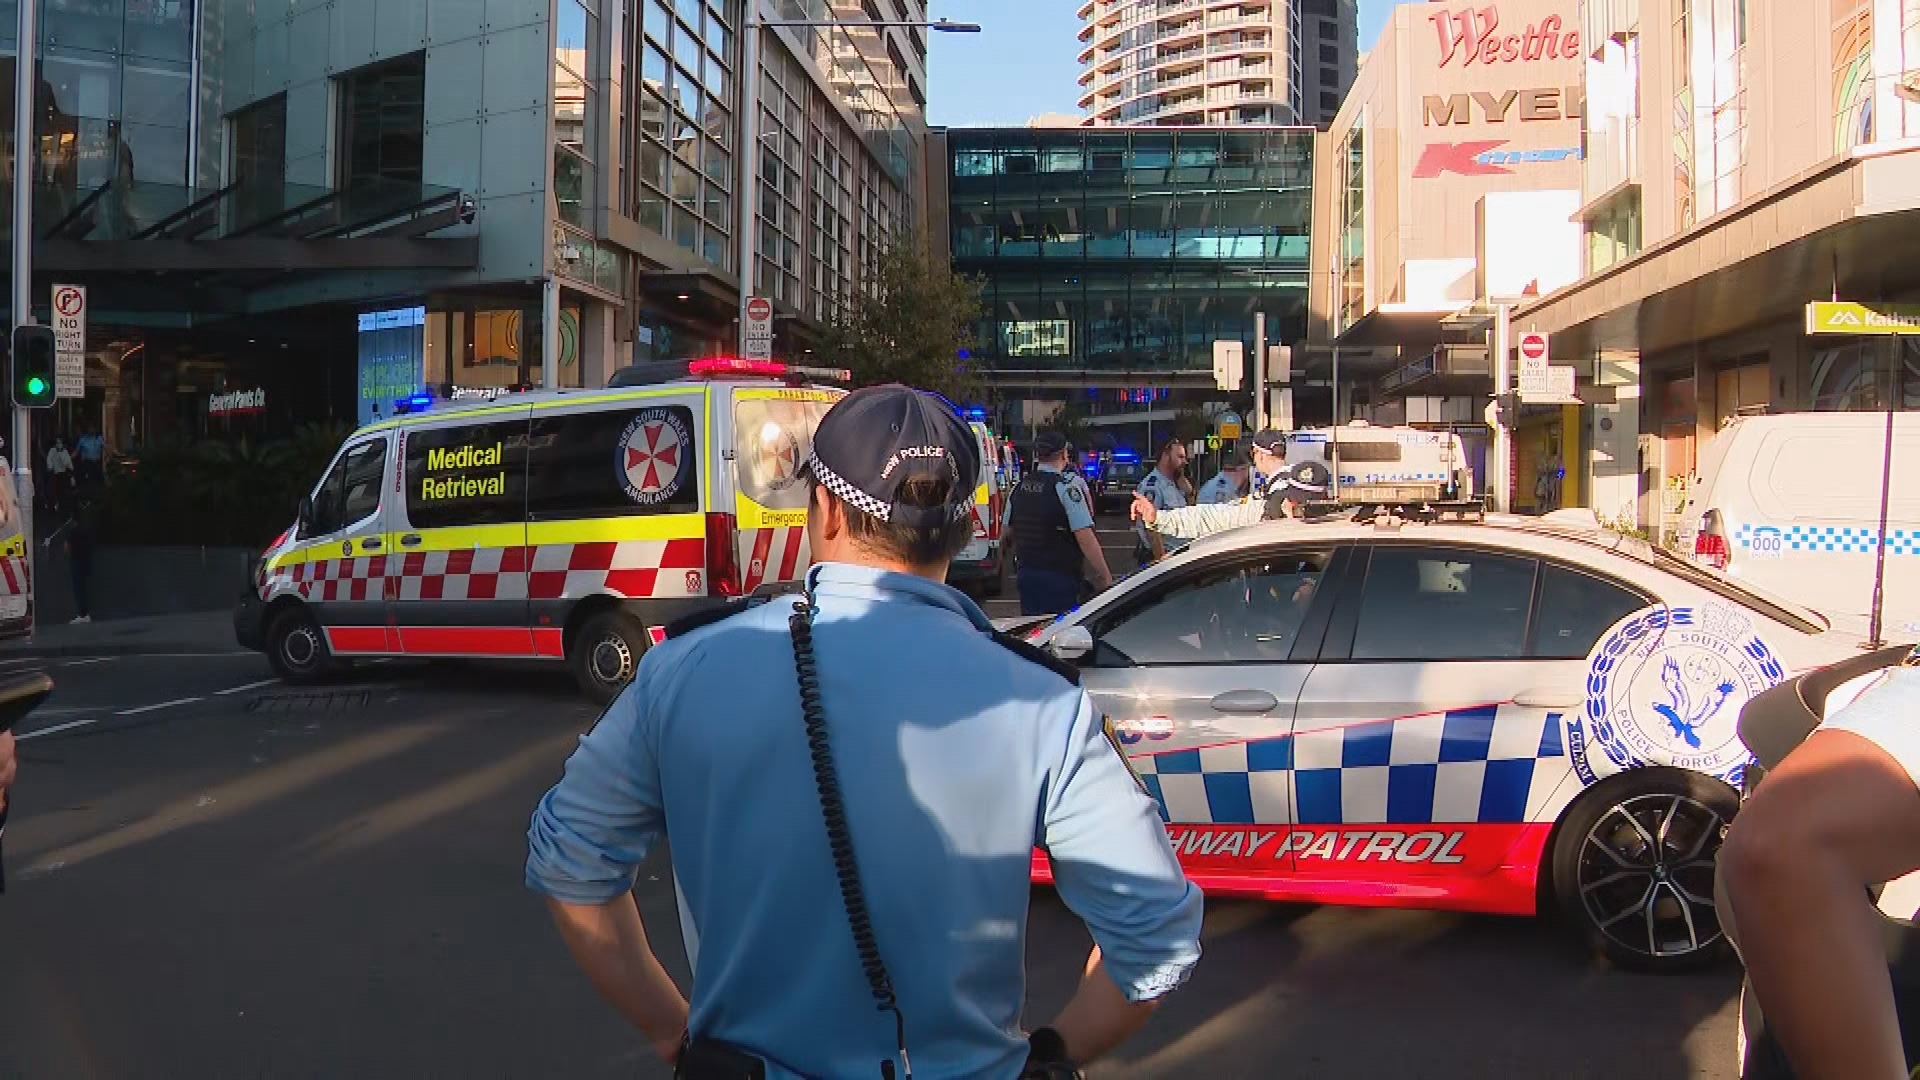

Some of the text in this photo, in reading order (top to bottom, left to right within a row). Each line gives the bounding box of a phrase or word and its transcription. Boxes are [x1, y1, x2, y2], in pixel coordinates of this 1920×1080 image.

[1428, 4, 1579, 68] Westfie
[60, 317, 78, 329] NO
[752, 323, 766, 331] NO
[1864, 311, 1920, 327] Kathm
[56, 331, 81, 339] RIGHT
[57, 339, 81, 349] TURN
[1526, 361, 1540, 369] NO
[209, 391, 236, 412] General
[235, 389, 255, 408] Pants
[619, 409, 689, 449] NEW SOUTH WALES
[427, 441, 502, 471] Medical
[900, 445, 945, 460] POLICE
[422, 471, 505, 501] Retrieval
[624, 481, 679, 504] AMBULANCE
[762, 511, 808, 527] Emergency
[1752, 537, 1781, 551] 000
[1681, 633, 1729, 655] SOUTH
[1737, 660, 1761, 696] WALE
[1617, 709, 1722, 768] POLICE FORCE
[1166, 829, 1466, 863] HWAY PATROL
